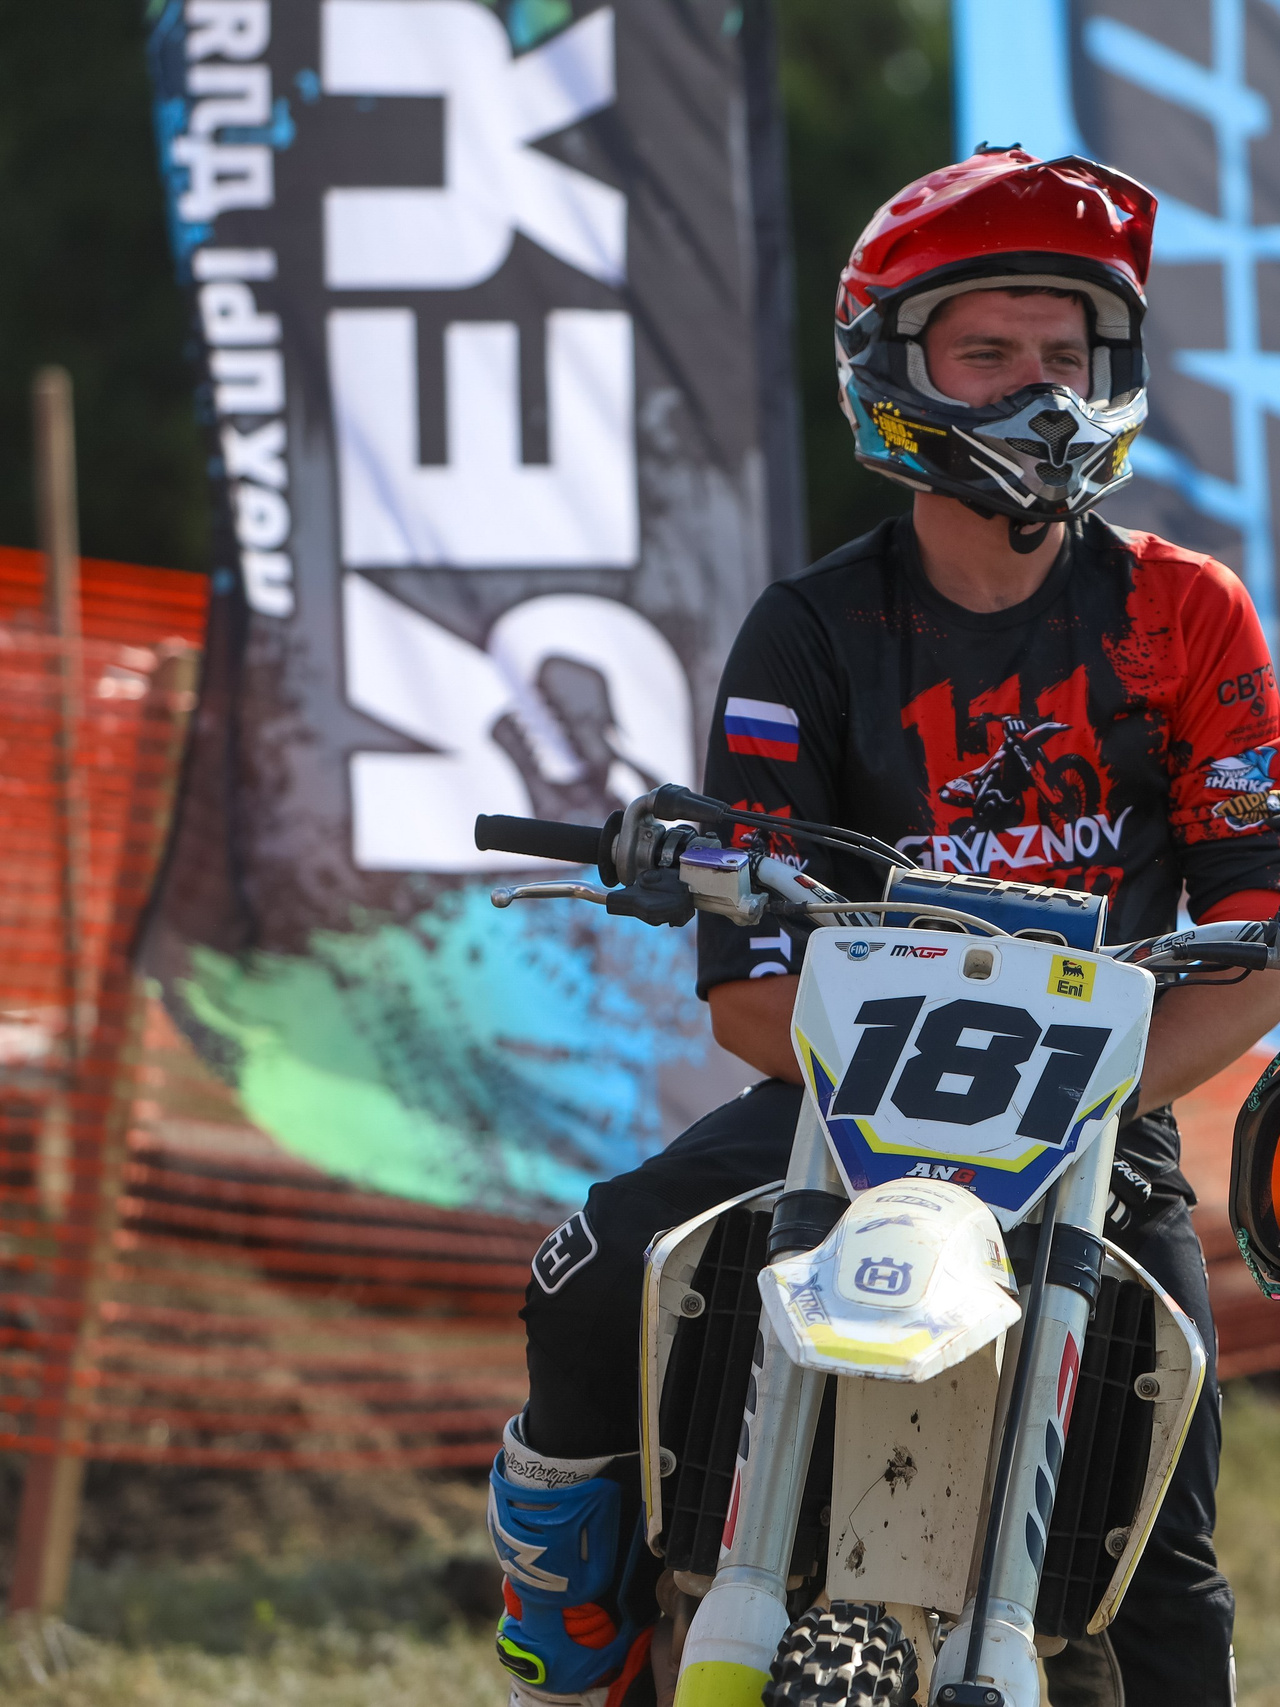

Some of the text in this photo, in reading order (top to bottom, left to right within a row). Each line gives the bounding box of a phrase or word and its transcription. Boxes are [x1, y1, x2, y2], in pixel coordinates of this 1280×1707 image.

[894, 804, 1134, 874] GRYAZNOV
[900, 868, 1094, 910] SCAR
[850, 944, 868, 955] FIM
[890, 944, 949, 959] MXGP
[1151, 930, 1196, 955] SCAR
[1055, 979, 1083, 998] Eni
[830, 995, 1113, 1146] 181
[905, 1162, 977, 1183] ANG
